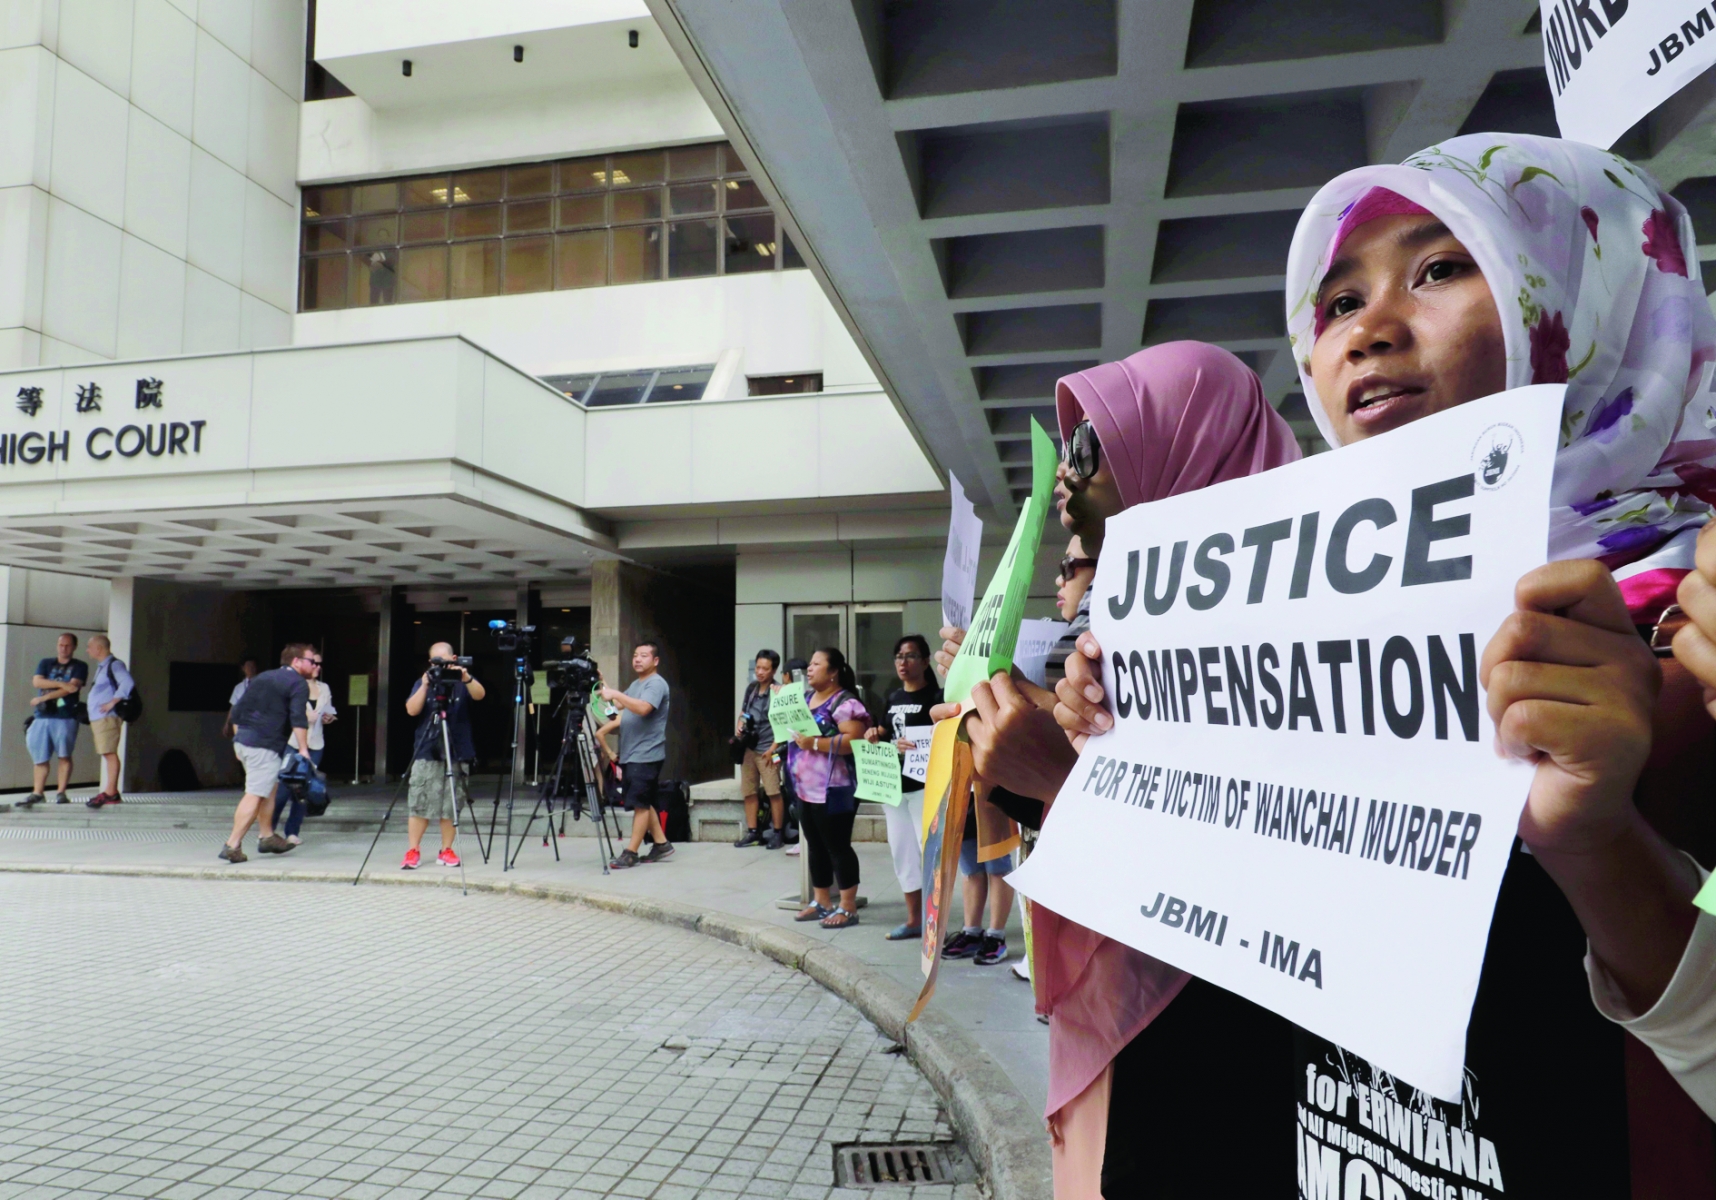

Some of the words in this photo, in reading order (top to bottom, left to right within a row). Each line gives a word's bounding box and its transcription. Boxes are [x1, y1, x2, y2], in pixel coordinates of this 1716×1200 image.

[86, 420, 206, 460] COURT
[1108, 473, 1475, 621] JUSTICE
[773, 694, 799, 708] ENSURE
[1113, 633, 1479, 742] COMPENSATION
[1083, 756, 1128, 798] FOR
[1124, 764, 1162, 809] THE
[1162, 769, 1220, 825] VICTIM
[1225, 777, 1249, 830] OF
[1253, 781, 1359, 854] WANCHAI
[1360, 800, 1482, 880] MURDER
[1140, 892, 1229, 947] JBMI
[1239, 939, 1249, 948] -
[1259, 931, 1322, 989] IMA
[1306, 1063, 1352, 1118] for
[1358, 1082, 1504, 1192] ERWIANA
[1326, 1121, 1385, 1168] Migrant
[1386, 1148, 1457, 1200] Domestic
